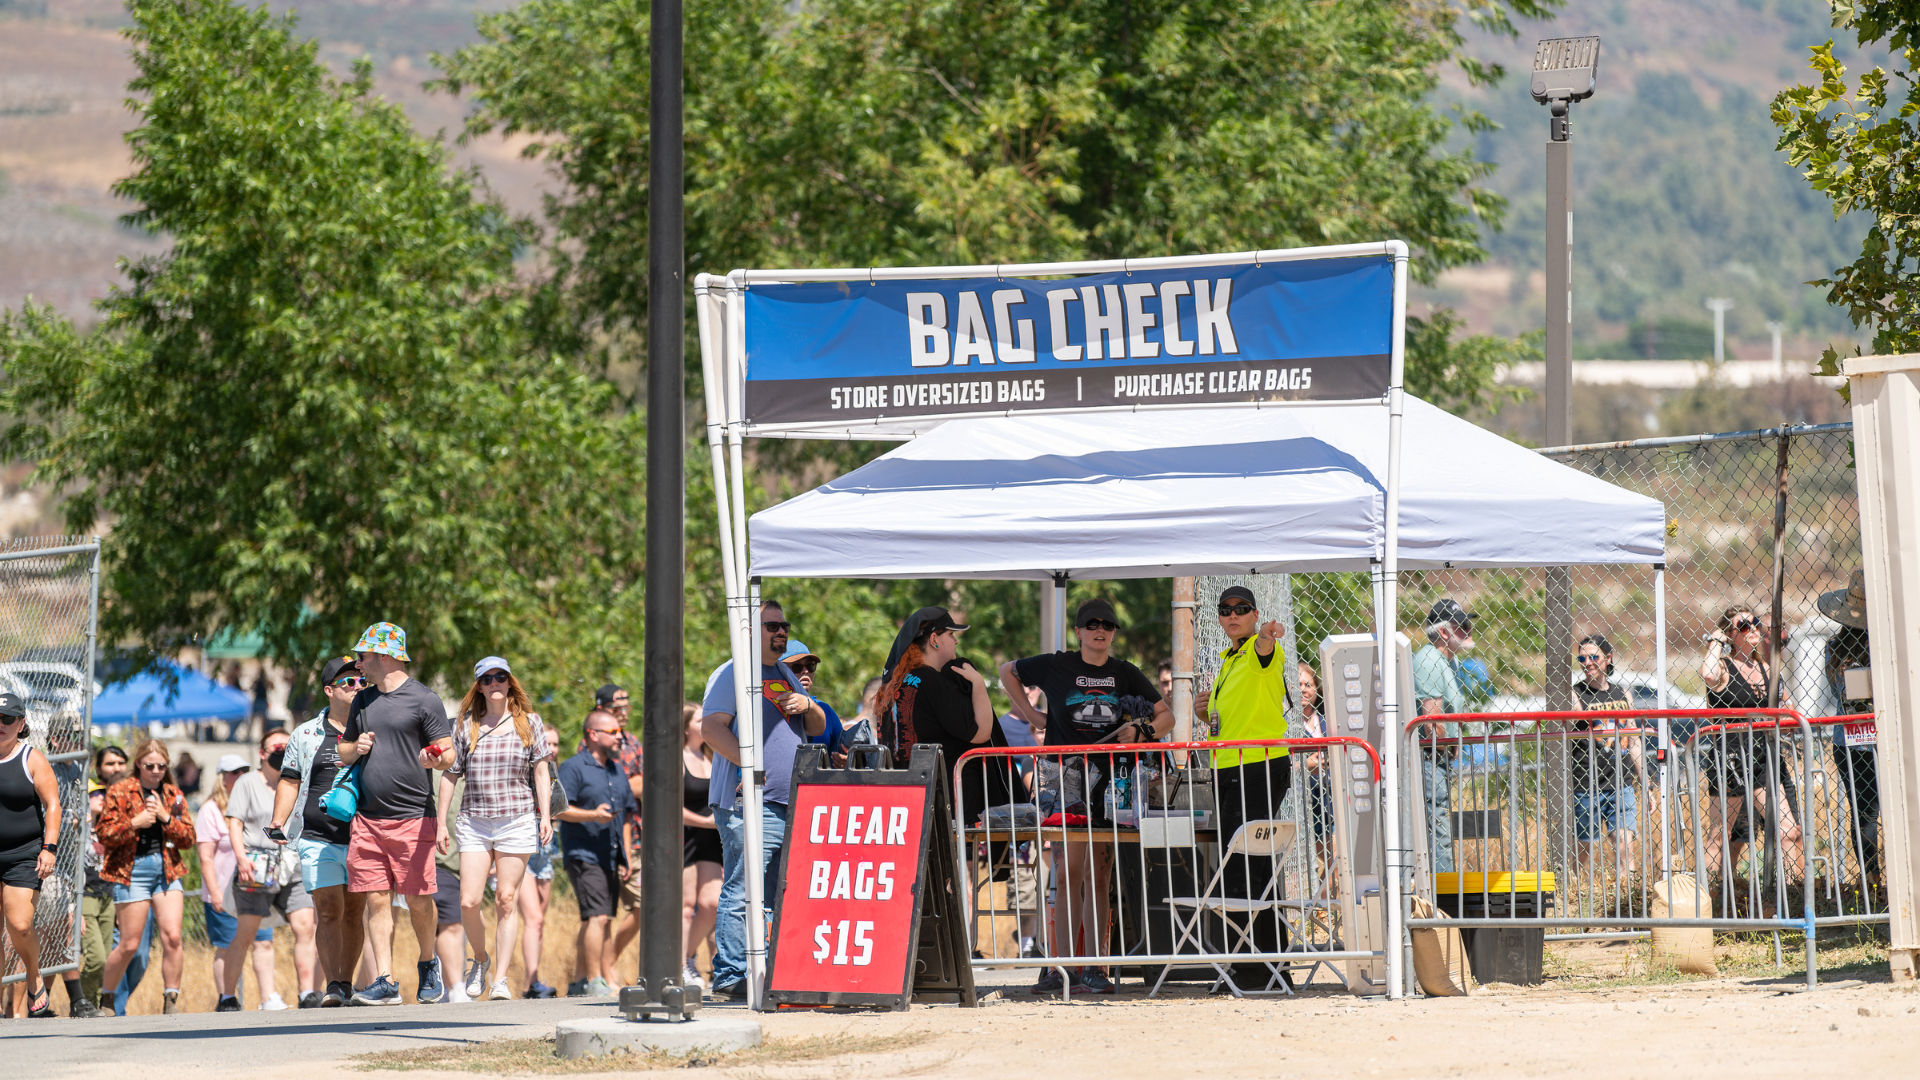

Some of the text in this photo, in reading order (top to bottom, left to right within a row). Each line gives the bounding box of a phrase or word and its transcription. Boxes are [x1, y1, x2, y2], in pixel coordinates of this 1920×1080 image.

[906, 278, 1240, 367] BAG CHECK
[830, 379, 1045, 409] STORE OVERSIZED BAGS
[1114, 367, 1312, 397] PURCHASE CLEAR BAGS
[1077, 677, 1087, 686] 3
[809, 805, 909, 845] CLEAR
[808, 860, 895, 901] BAGS
[812, 919, 874, 966] $15
